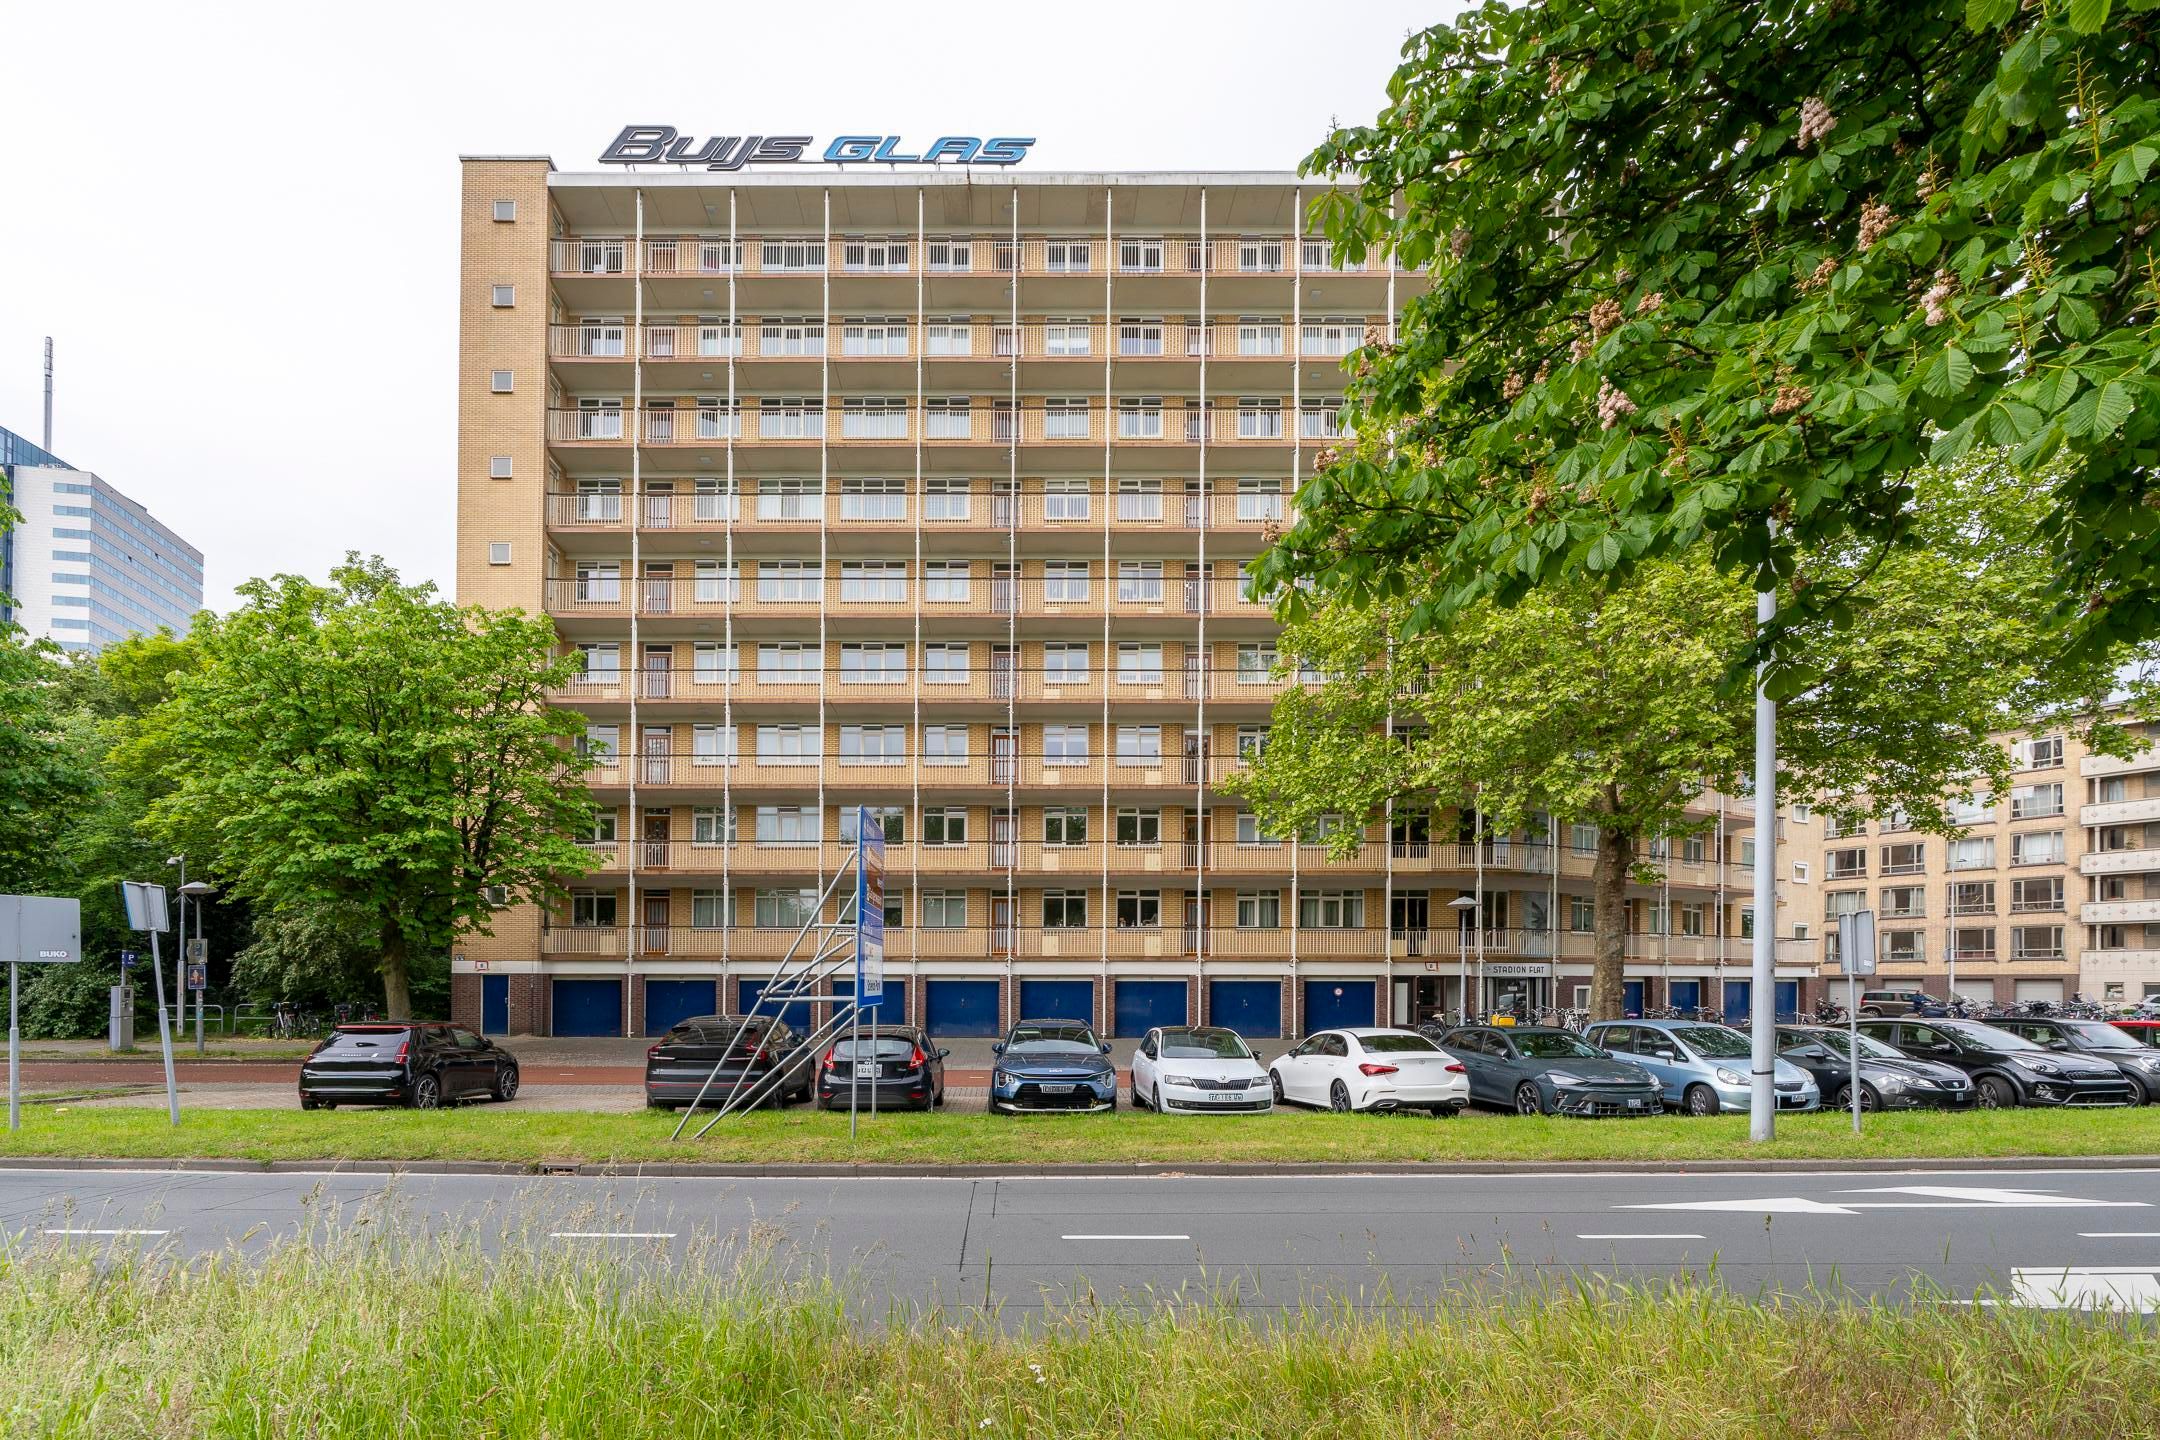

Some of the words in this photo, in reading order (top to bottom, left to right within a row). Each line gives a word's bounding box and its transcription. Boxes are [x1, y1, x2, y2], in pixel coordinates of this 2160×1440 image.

[823, 136, 1036, 163] GLAS
[39, 950, 67, 958] BUKO
[1493, 966, 1526, 974] STADION
[1529, 966, 1545, 974] FLAT
